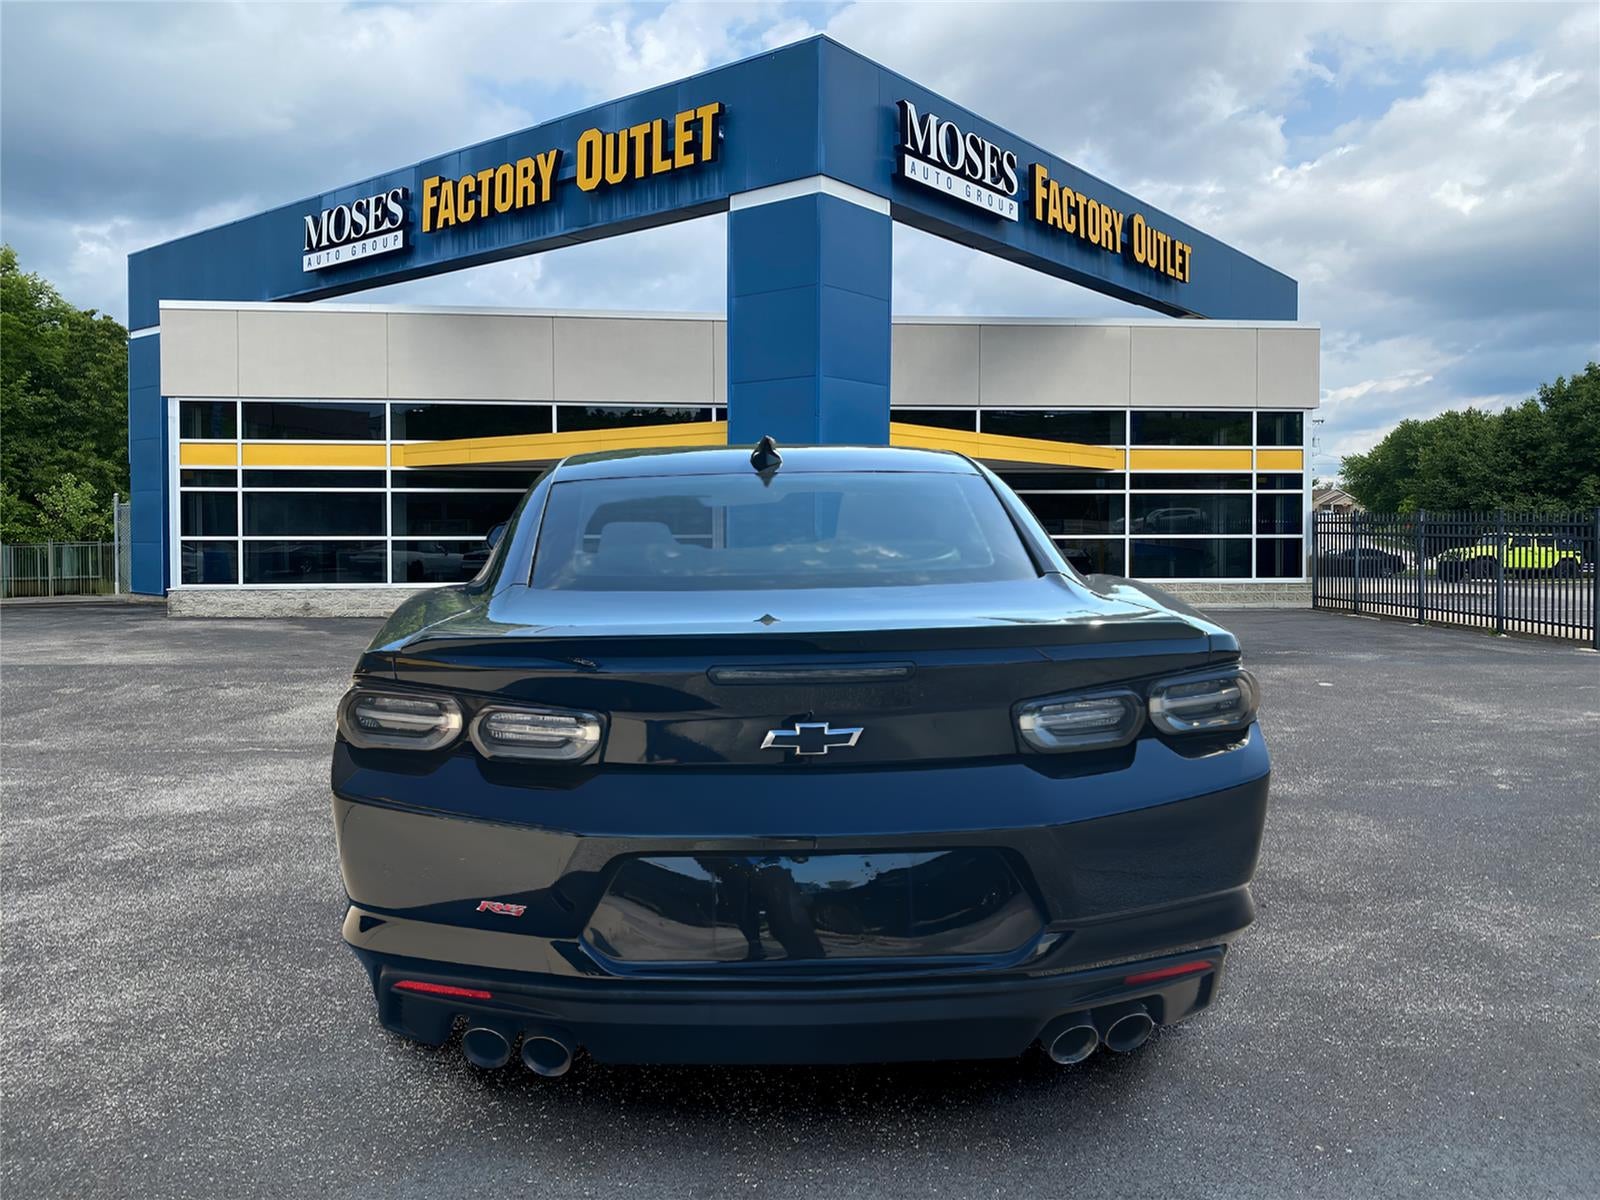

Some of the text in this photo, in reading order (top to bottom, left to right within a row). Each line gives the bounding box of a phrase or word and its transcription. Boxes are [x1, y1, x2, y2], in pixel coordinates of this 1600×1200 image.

[421, 101, 720, 233] FACTORY OUTLET
[904, 99, 1018, 196] MOSES
[910, 161, 1015, 215] AUTO GROUP
[303, 188, 405, 253] MOSES
[306, 236, 401, 268] AUTO GROUP
[1034, 163, 1192, 284] FACTORY OUTLET
